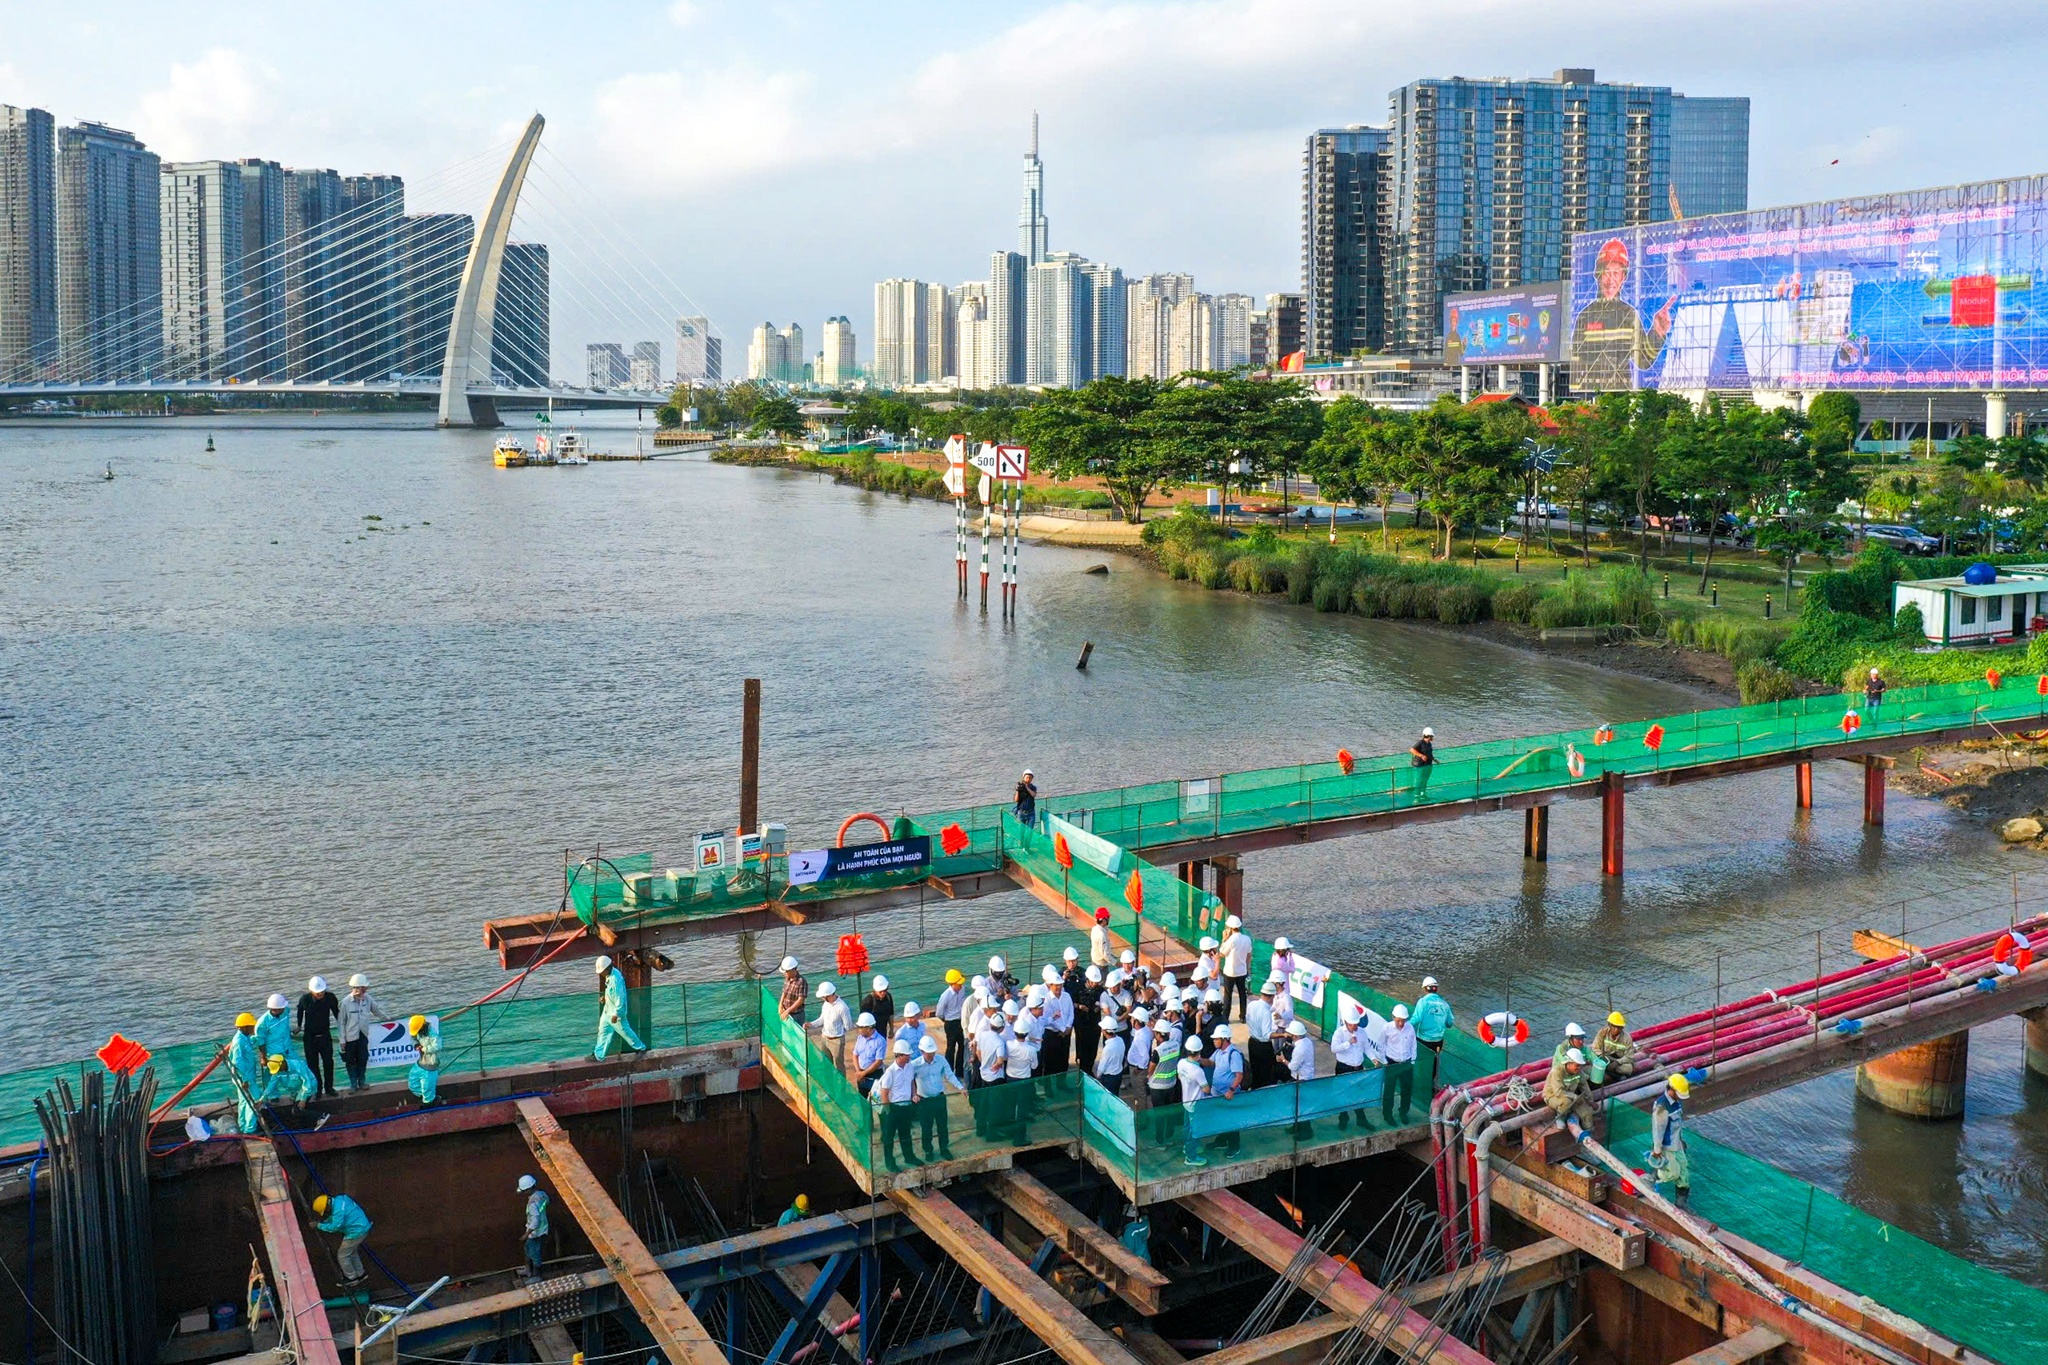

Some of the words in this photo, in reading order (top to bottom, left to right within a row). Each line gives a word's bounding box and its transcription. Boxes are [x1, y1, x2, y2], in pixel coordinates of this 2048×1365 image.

[1712, 237, 1726, 248] GIA
[1727, 234, 1748, 246] ĐÌNH
[1905, 371, 1924, 383] GIA
[1926, 369, 1954, 383] ĐÌNH
[977, 456, 995, 467] 500
[863, 848, 879, 857] TOÀN
[880, 846, 891, 855] CỦA
[892, 845, 905, 855] BẠN
[837, 861, 845, 871] LÀ
[846, 860, 863, 871] HẠNH
[863, 857, 879, 867] PHÚC
[369, 1044, 414, 1057] TPHUO
